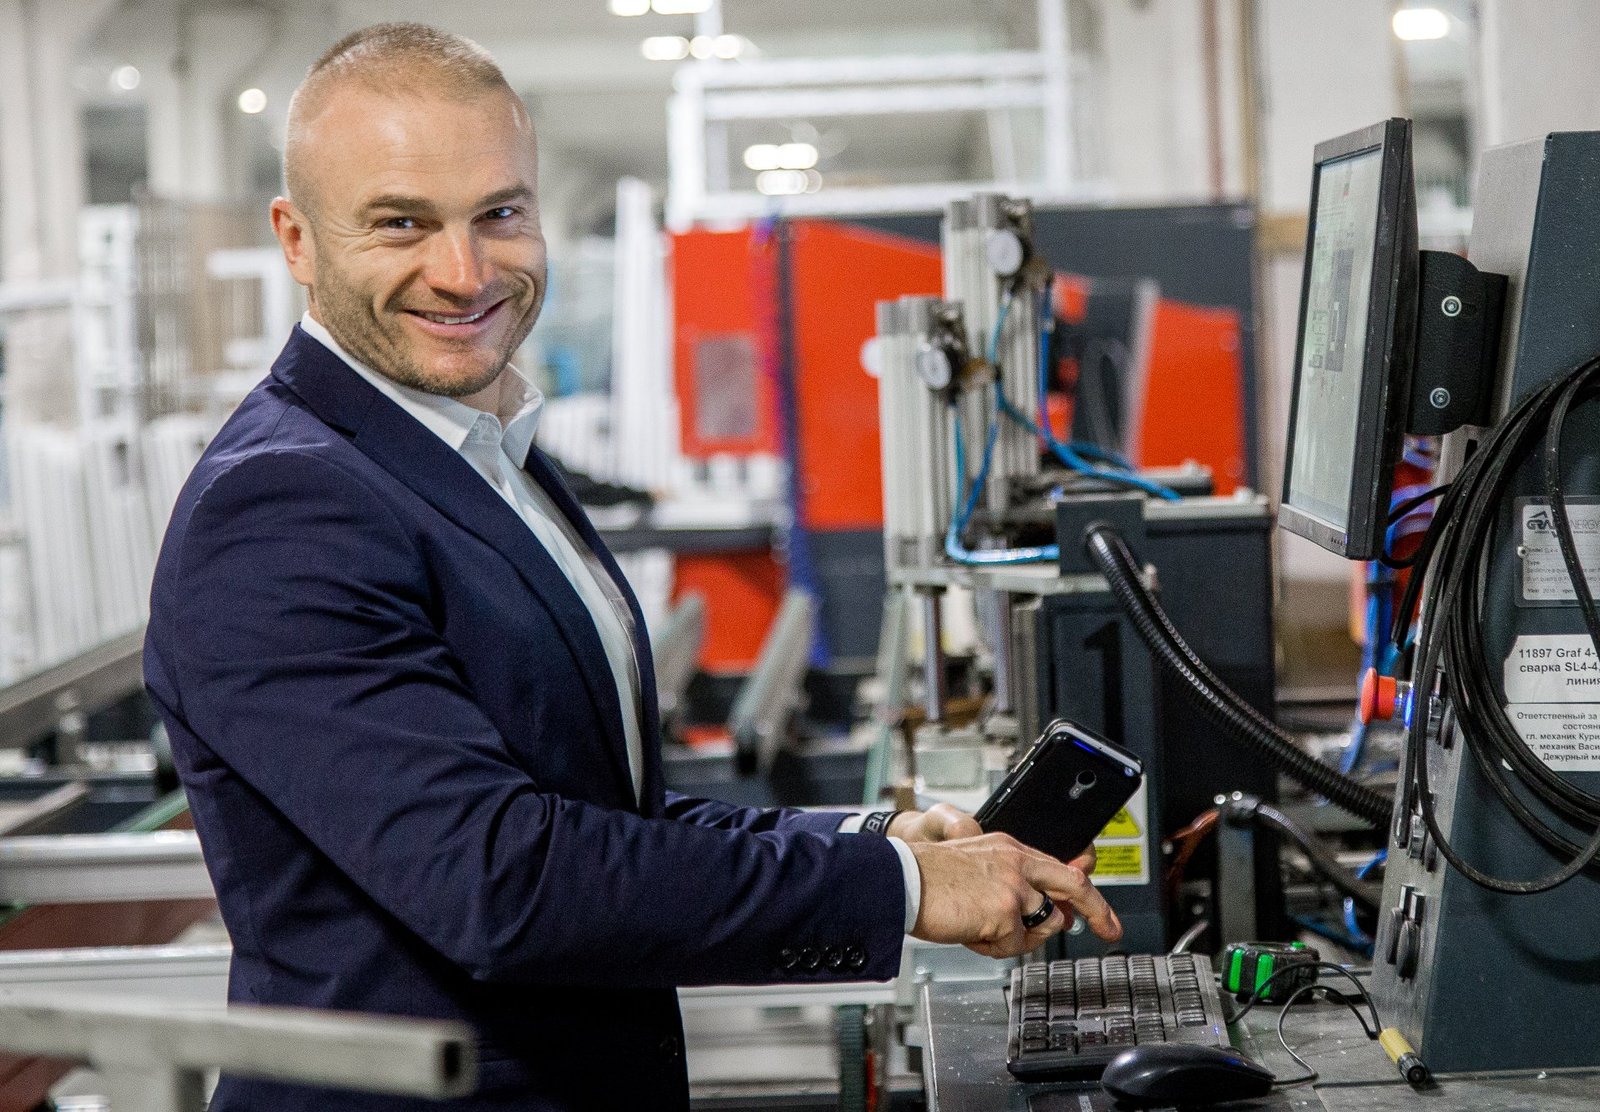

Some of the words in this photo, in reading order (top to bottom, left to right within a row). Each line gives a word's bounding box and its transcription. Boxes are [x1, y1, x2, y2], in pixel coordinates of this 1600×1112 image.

[1569, 519, 1600, 530] NERGY
[1519, 648, 1552, 658] 11897
[1556, 648, 1581, 658] Graf
[1584, 648, 1598, 658] 4-
[1519, 664, 1561, 674] сварка
[1517, 711, 1586, 720] Ответственный
[1578, 733, 1600, 742] Кури
[1543, 752, 1589, 762] Дежурный
